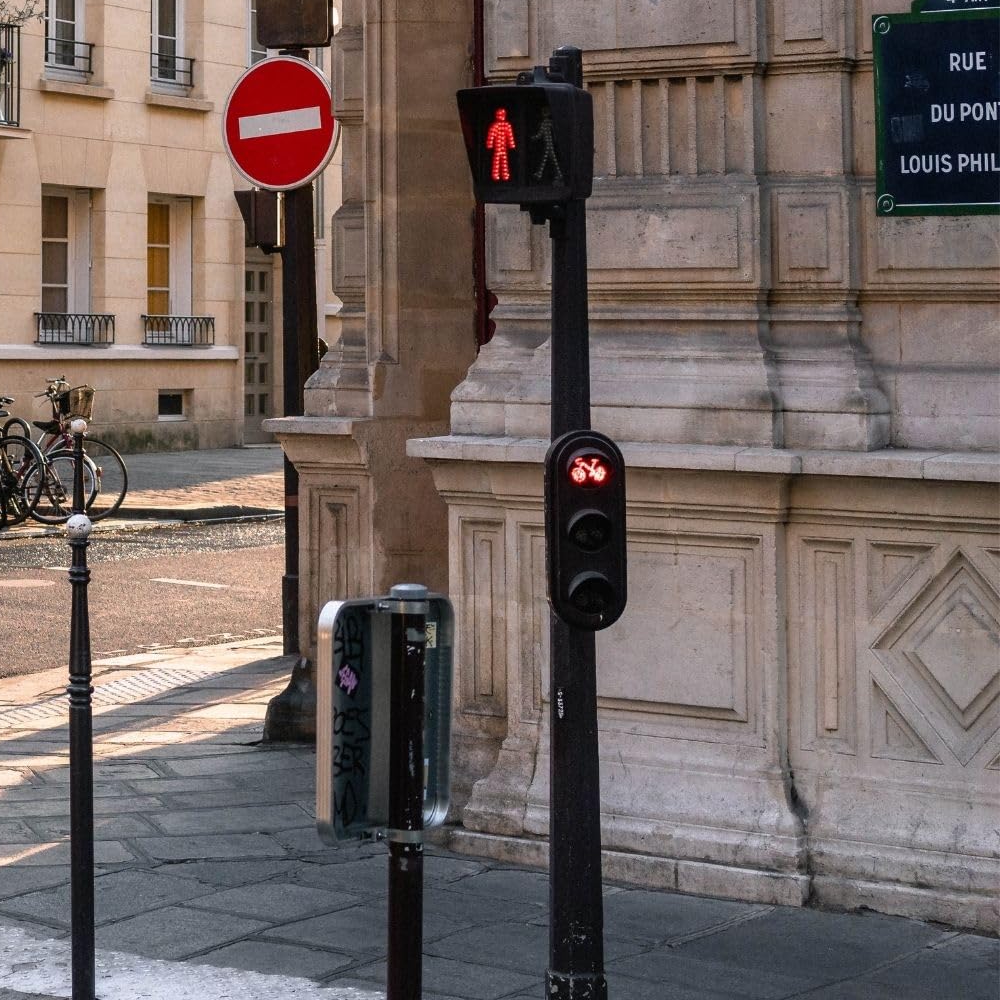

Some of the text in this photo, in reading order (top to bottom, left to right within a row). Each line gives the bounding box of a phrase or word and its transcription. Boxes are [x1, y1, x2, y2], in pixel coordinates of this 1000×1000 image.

[949, 51, 988, 72] RUE
[930, 101, 1000, 123] DU PON
[900, 154, 953, 174] LOUIS
